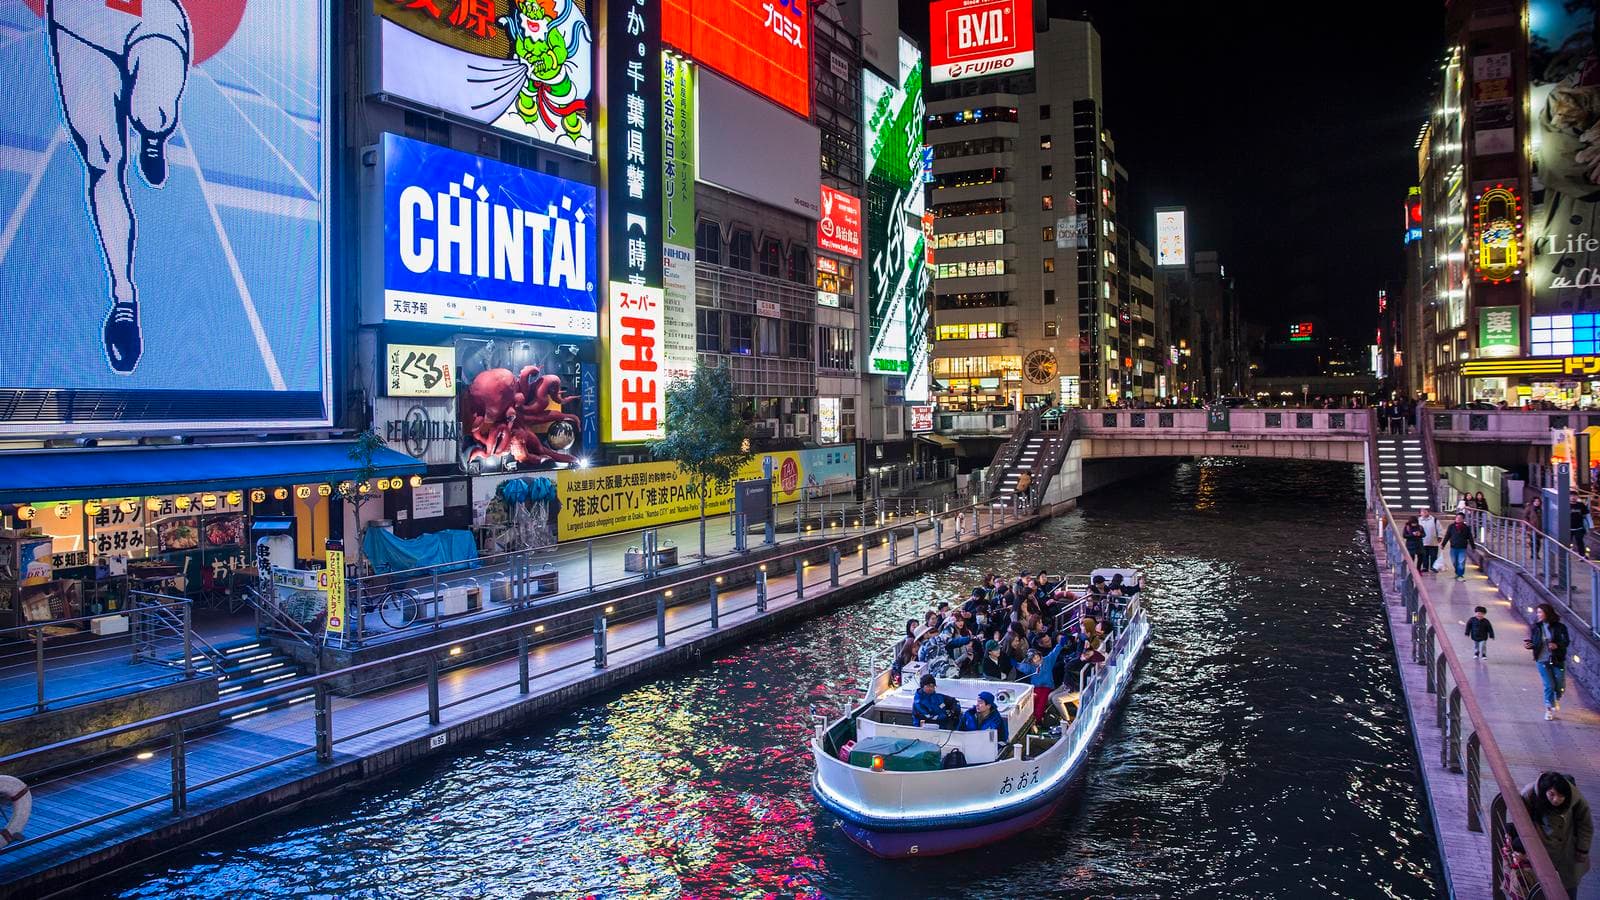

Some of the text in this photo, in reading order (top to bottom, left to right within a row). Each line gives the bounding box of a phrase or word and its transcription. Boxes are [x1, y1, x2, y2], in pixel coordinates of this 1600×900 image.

[762, 3, 803, 48] プロミス
[958, 8, 1009, 49] B.V.D.
[964, 57, 1015, 74] FUJIBO
[626, 0, 646, 287] か。千葉県警【時
[400, 172, 586, 291] CHINTAI
[664, 247, 690, 261] NIHON
[1546, 232, 1600, 255] Life
[393, 299, 428, 315] 天気予報
[620, 291, 657, 312] スーパー
[1487, 311, 1513, 333] 薬
[400, 351, 443, 389] くくる
[619, 316, 658, 432] 玉出
[783, 460, 795, 475] TAX
[567, 522, 584, 532] Largest
[584, 520, 596, 529] class
[596, 516, 614, 528] shopping
[615, 515, 627, 525] center
[97, 530, 144, 552] お好み
[999, 766, 1040, 795] おおえ
